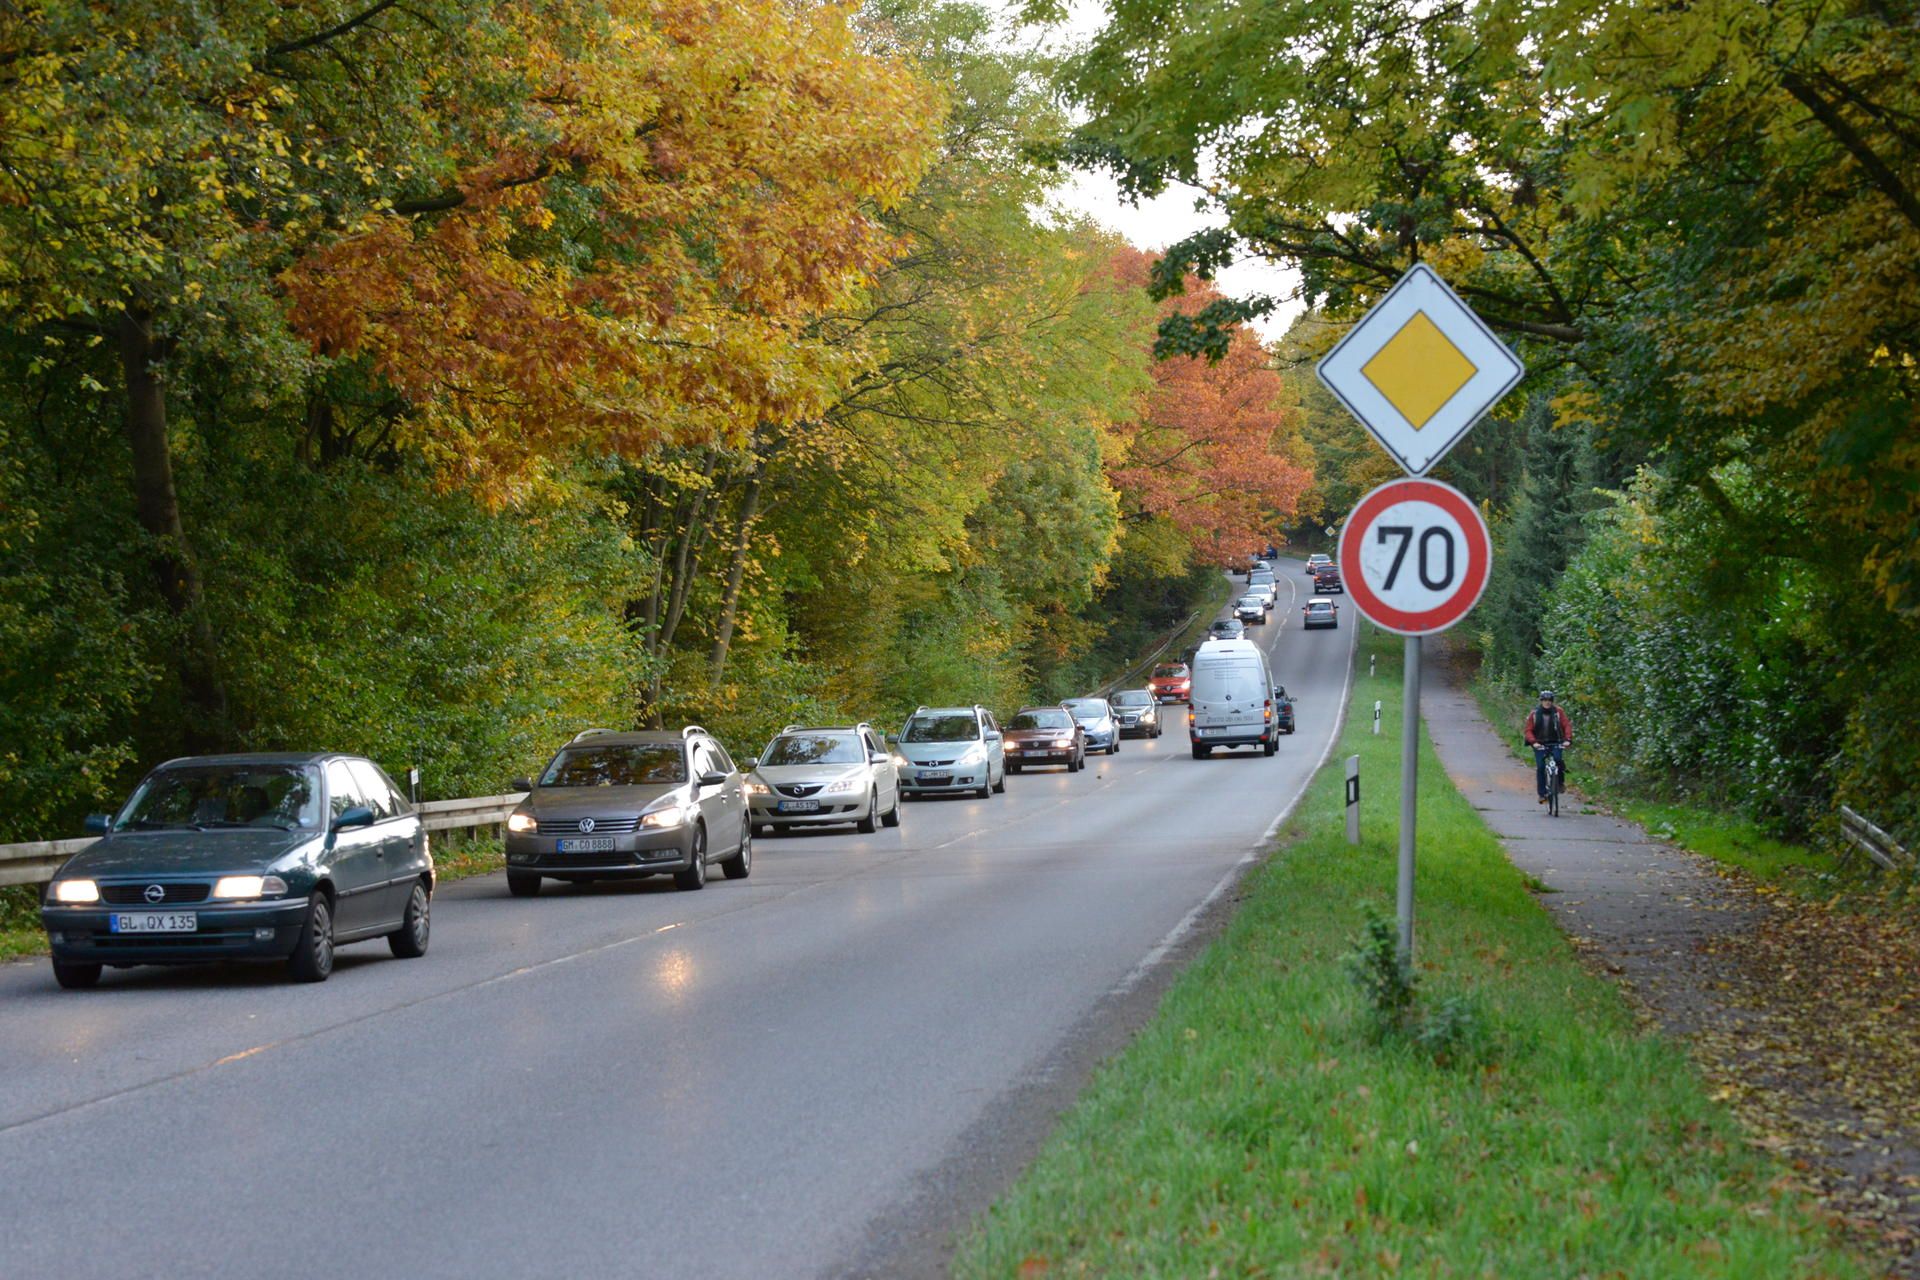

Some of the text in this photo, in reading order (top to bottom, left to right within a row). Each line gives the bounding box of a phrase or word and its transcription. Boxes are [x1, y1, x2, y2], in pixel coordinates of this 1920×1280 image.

[1377, 525, 1455, 592] 70
[119, 915, 195, 930] GL QX 135
